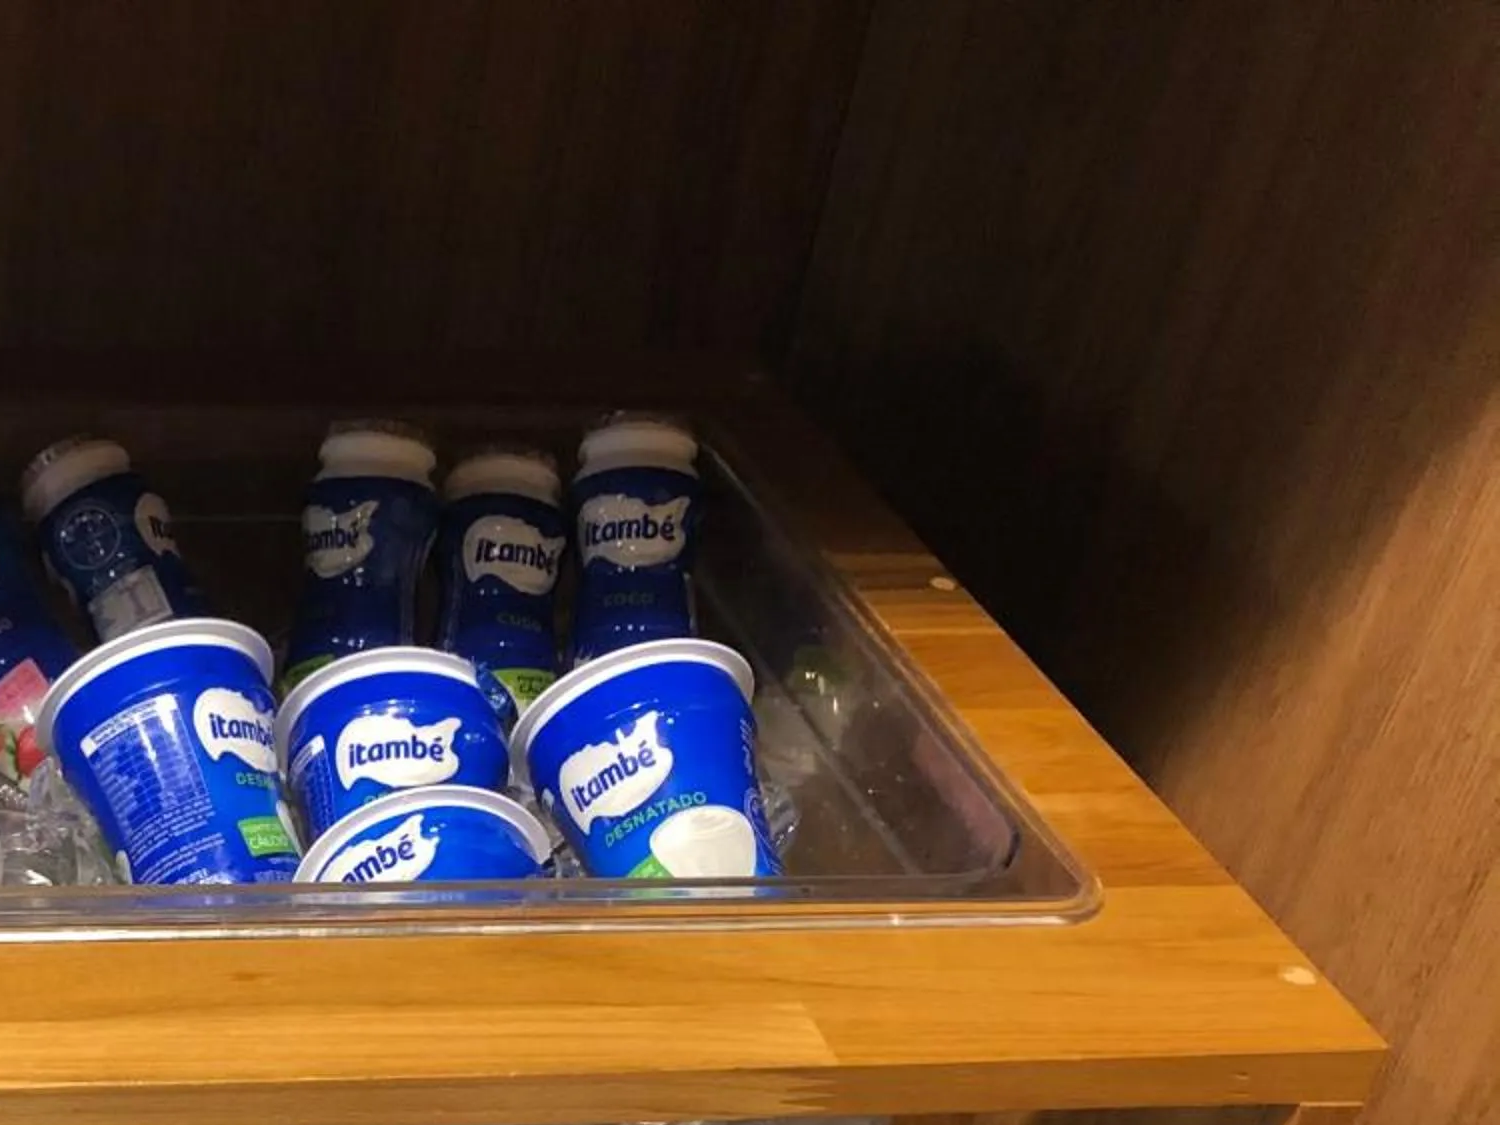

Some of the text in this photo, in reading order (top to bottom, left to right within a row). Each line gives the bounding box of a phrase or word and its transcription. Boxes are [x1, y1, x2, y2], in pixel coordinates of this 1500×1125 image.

[585, 513, 675, 547] itambé
[475, 537, 557, 575] itambé
[348, 734, 445, 769] itambé
[570, 739, 657, 813] itambé
[604, 791, 708, 849] DESNATADO
[341, 833, 416, 884] ambé
